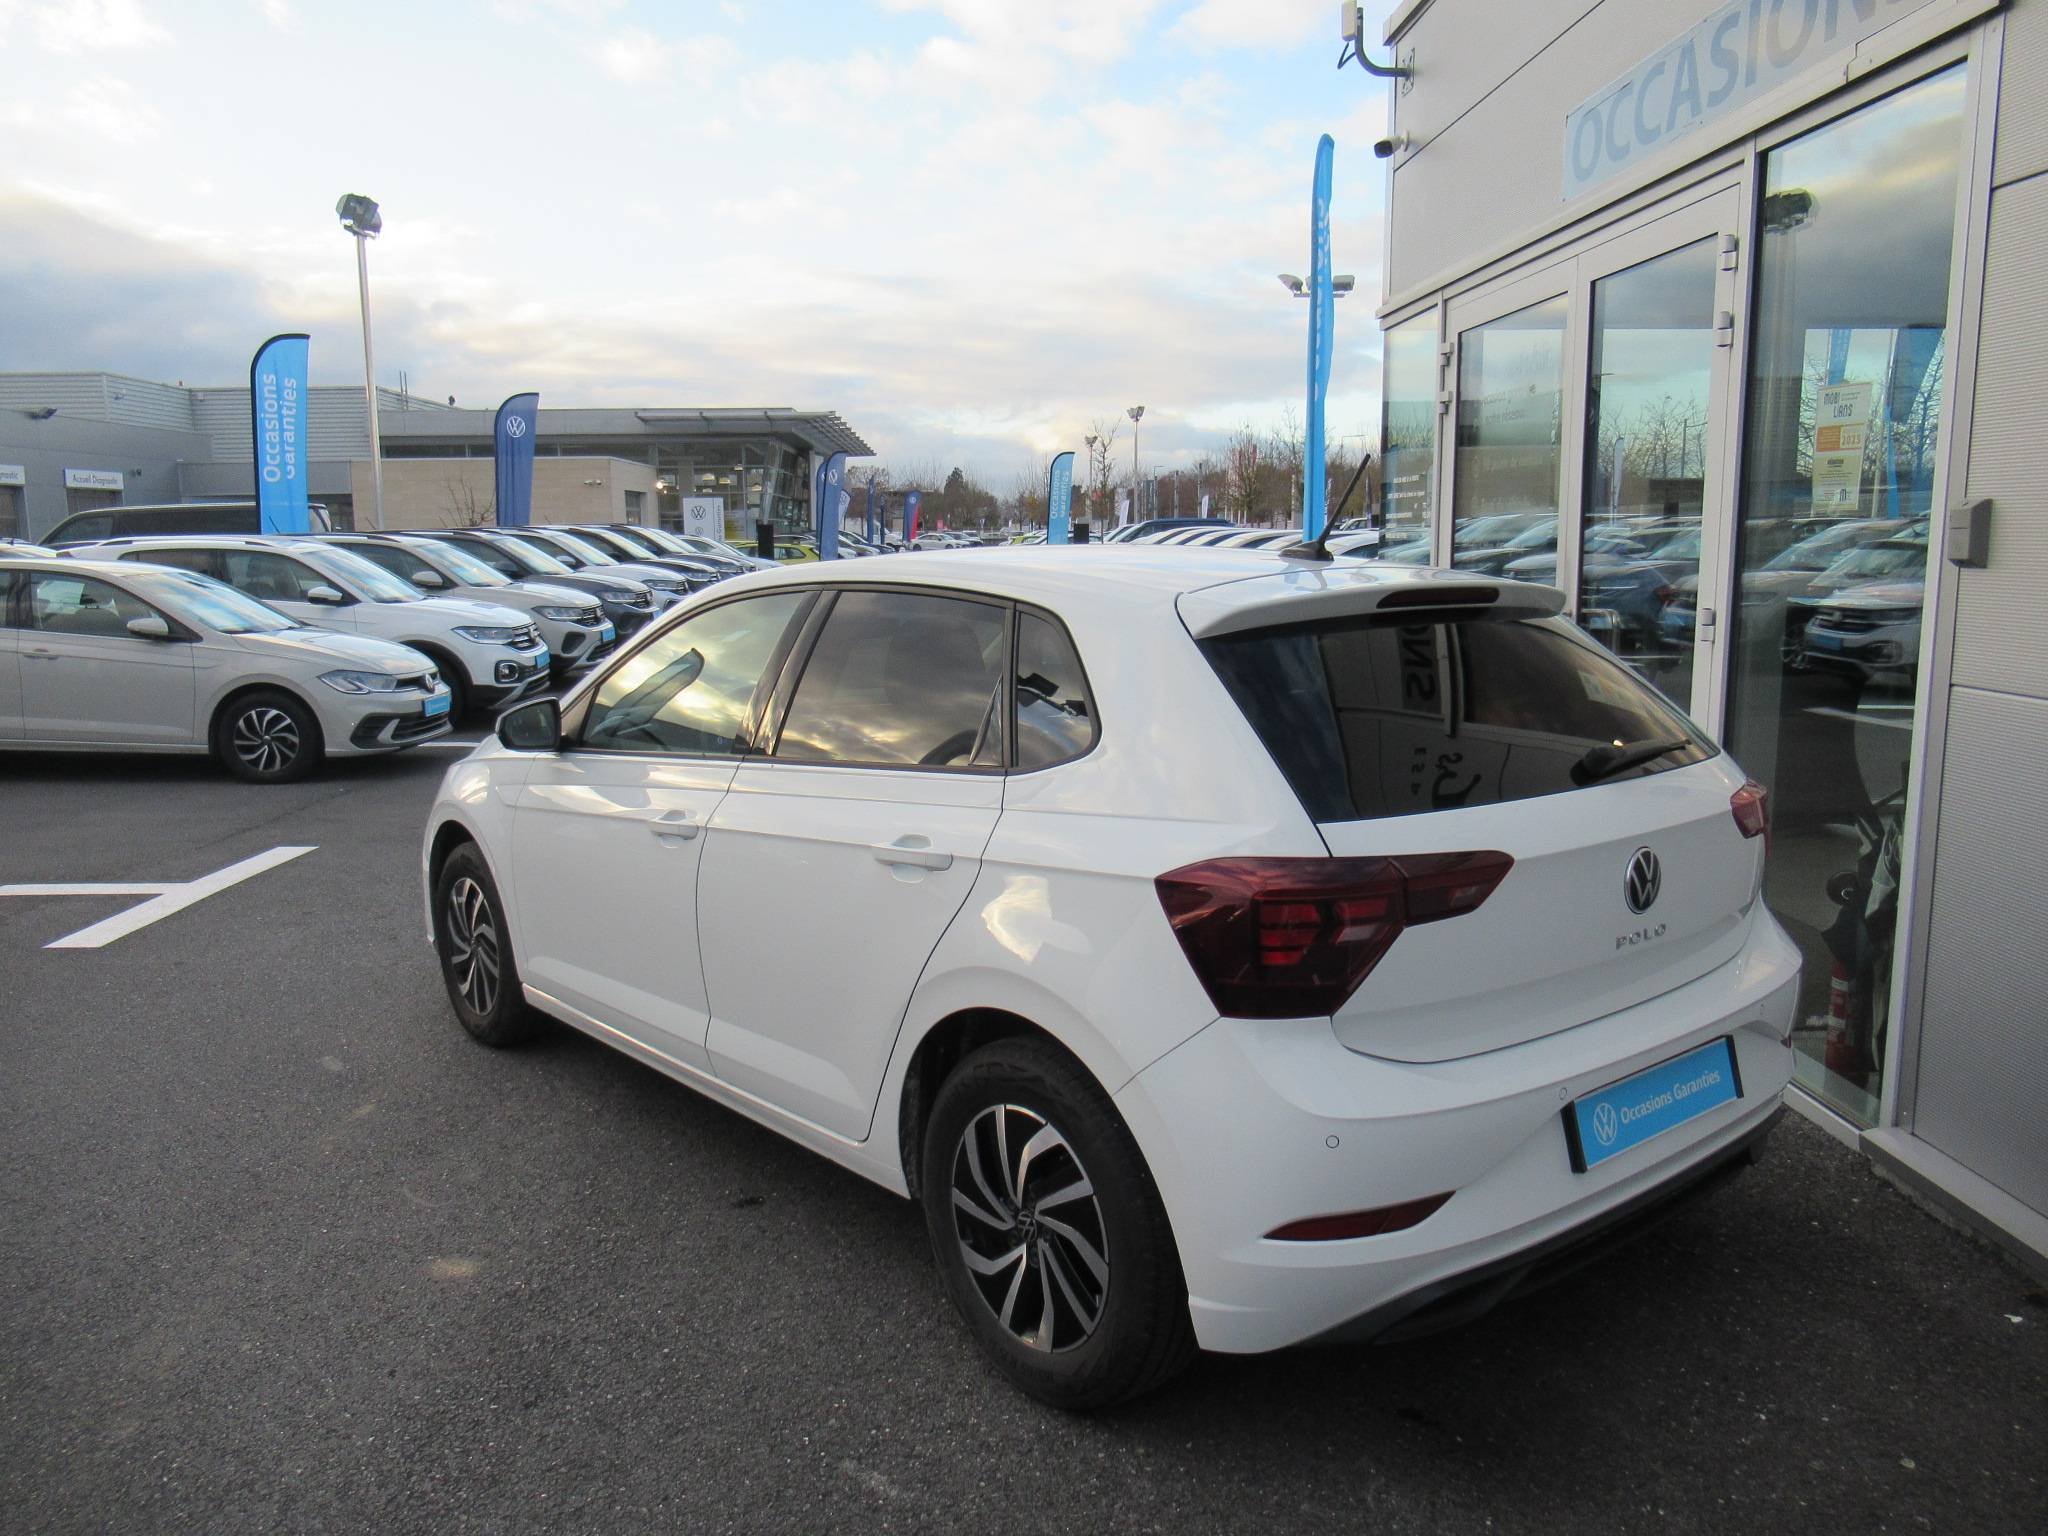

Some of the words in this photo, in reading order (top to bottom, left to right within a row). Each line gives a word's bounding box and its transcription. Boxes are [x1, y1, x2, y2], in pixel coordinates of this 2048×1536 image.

[1571, 0, 1898, 183] OCCASIO
[261, 373, 281, 483] Occasions
[1050, 470, 1060, 519] Occasions
[1615, 922, 1667, 950] POLO
[1620, 1094, 1672, 1124] Occasions
[1673, 1070, 1721, 1099] Garanties
